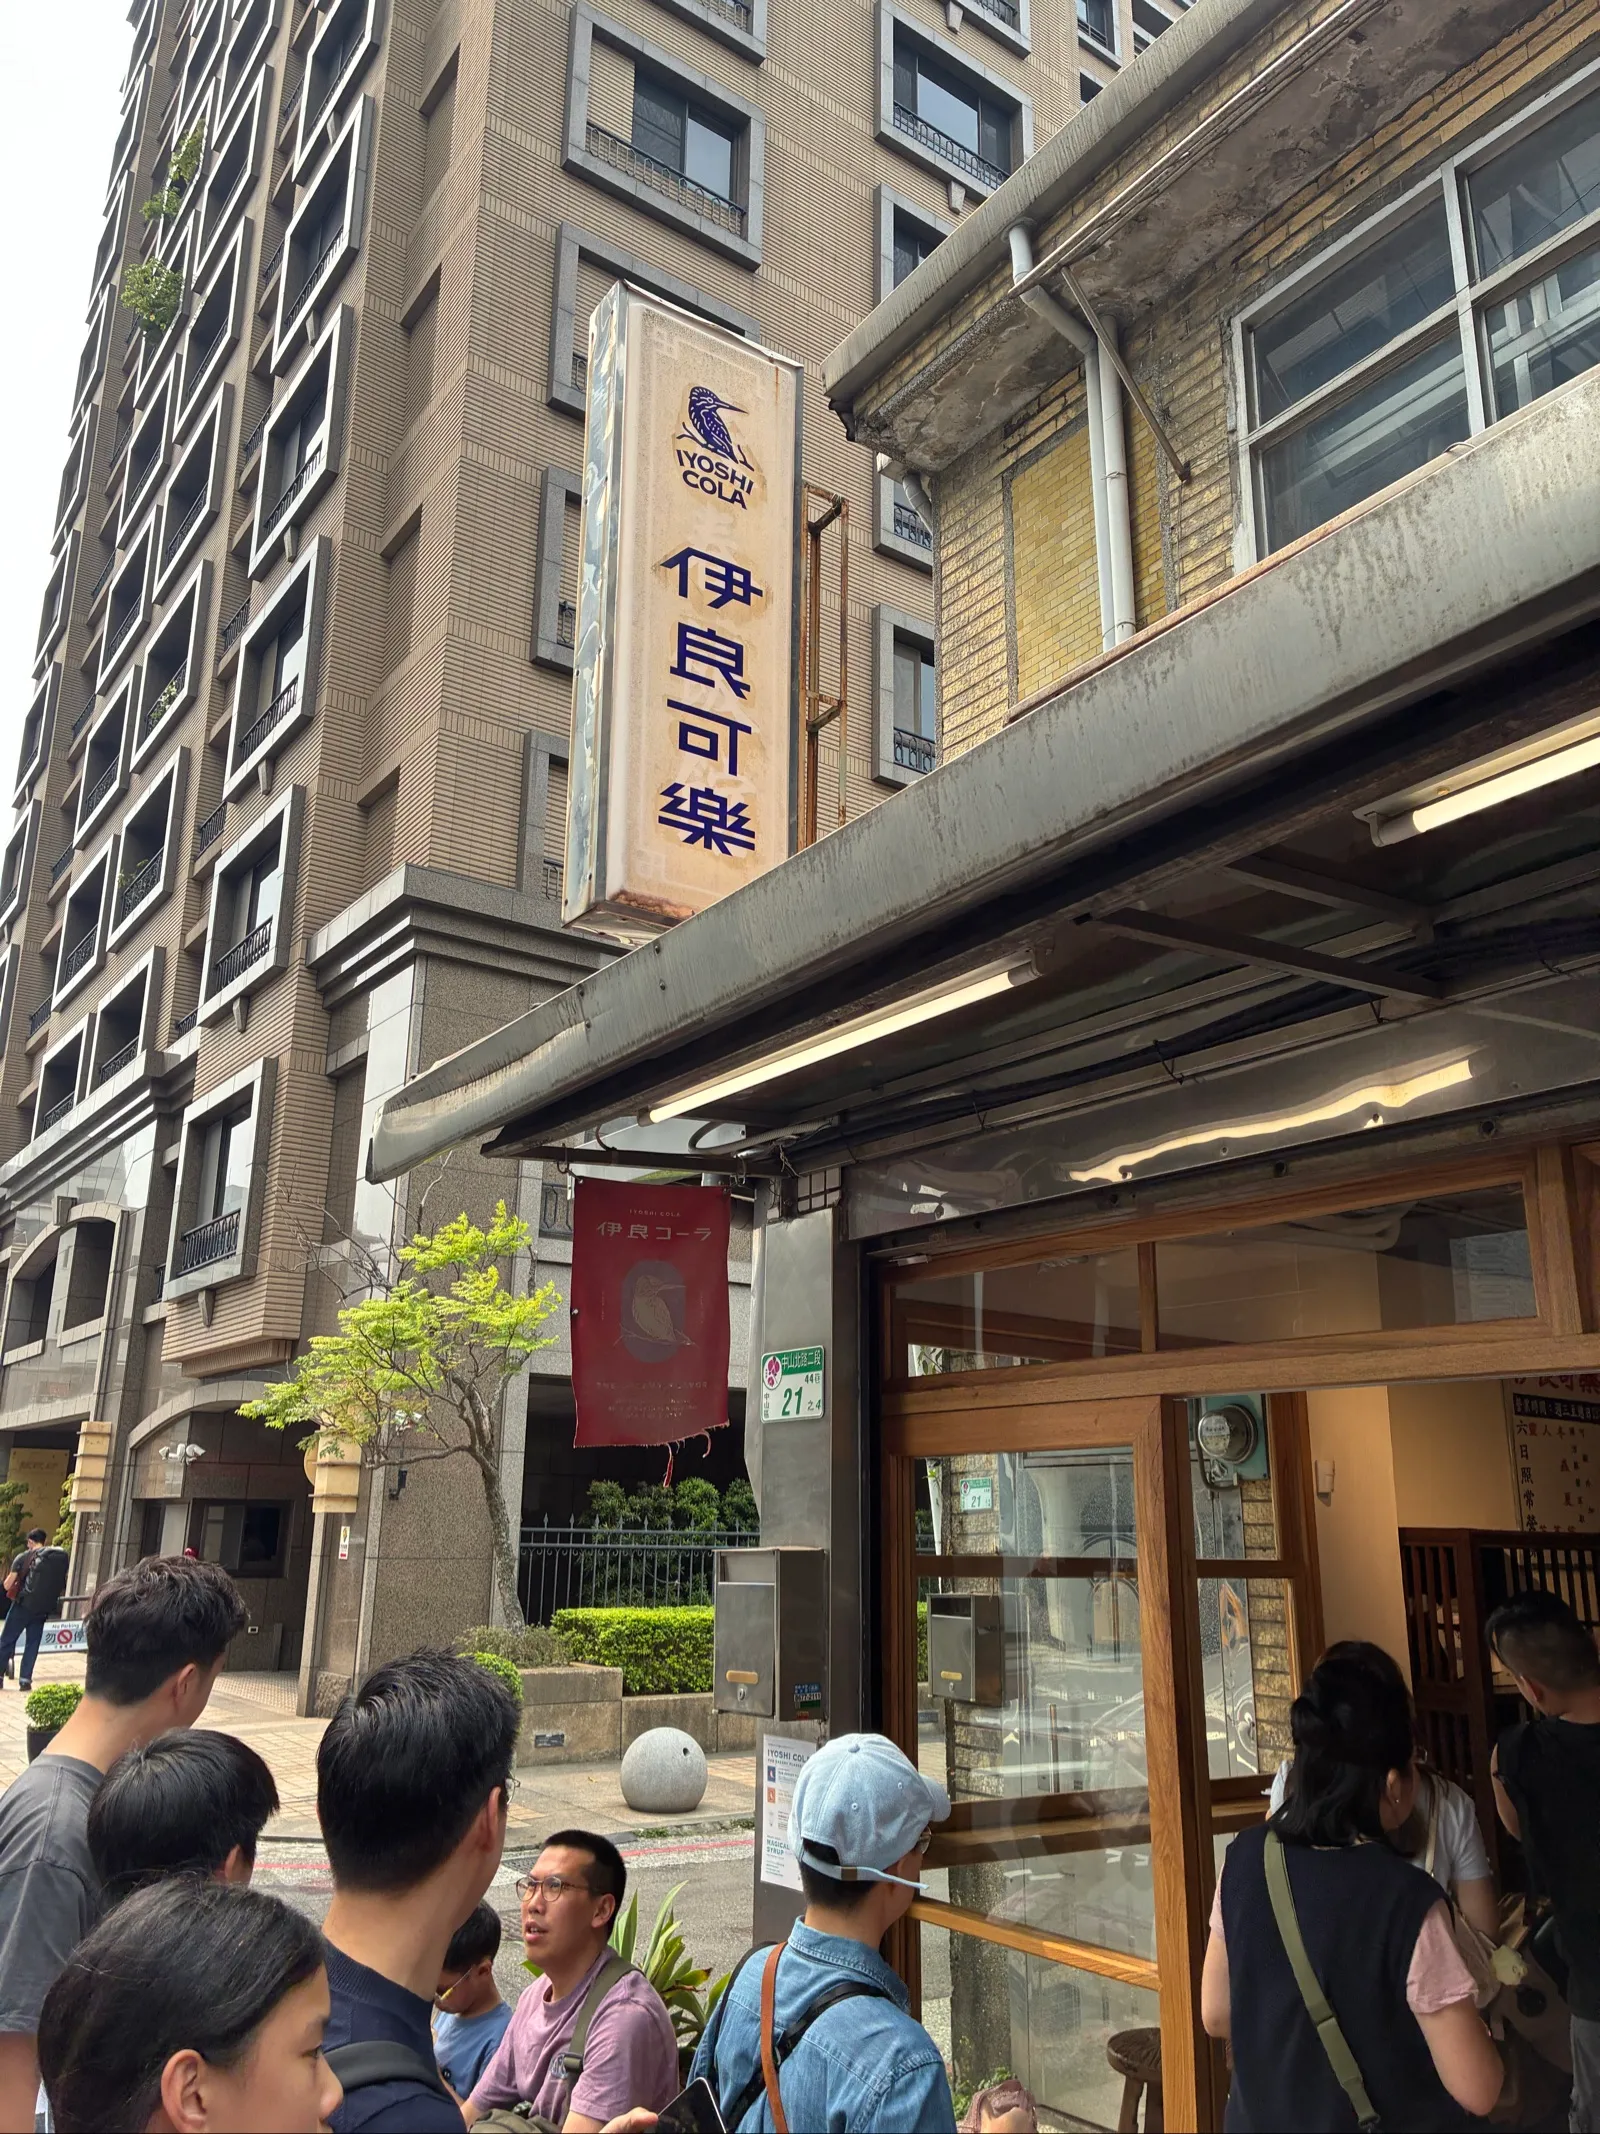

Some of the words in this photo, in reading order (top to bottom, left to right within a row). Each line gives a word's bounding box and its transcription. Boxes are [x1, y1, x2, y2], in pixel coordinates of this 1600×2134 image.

[676, 449, 754, 495] IYOSHI
[682, 470, 747, 510] COLA
[658, 547, 763, 856] 伊良可樂
[596, 1221, 712, 1241] 伊良コーラ
[781, 1350, 821, 1370] 中山北路二段
[782, 1386, 803, 1416] 21
[767, 1748, 791, 1760] IYOSHI
[766, 1838, 790, 1850] MAGICAL
[766, 1846, 784, 1856] SYRUP
